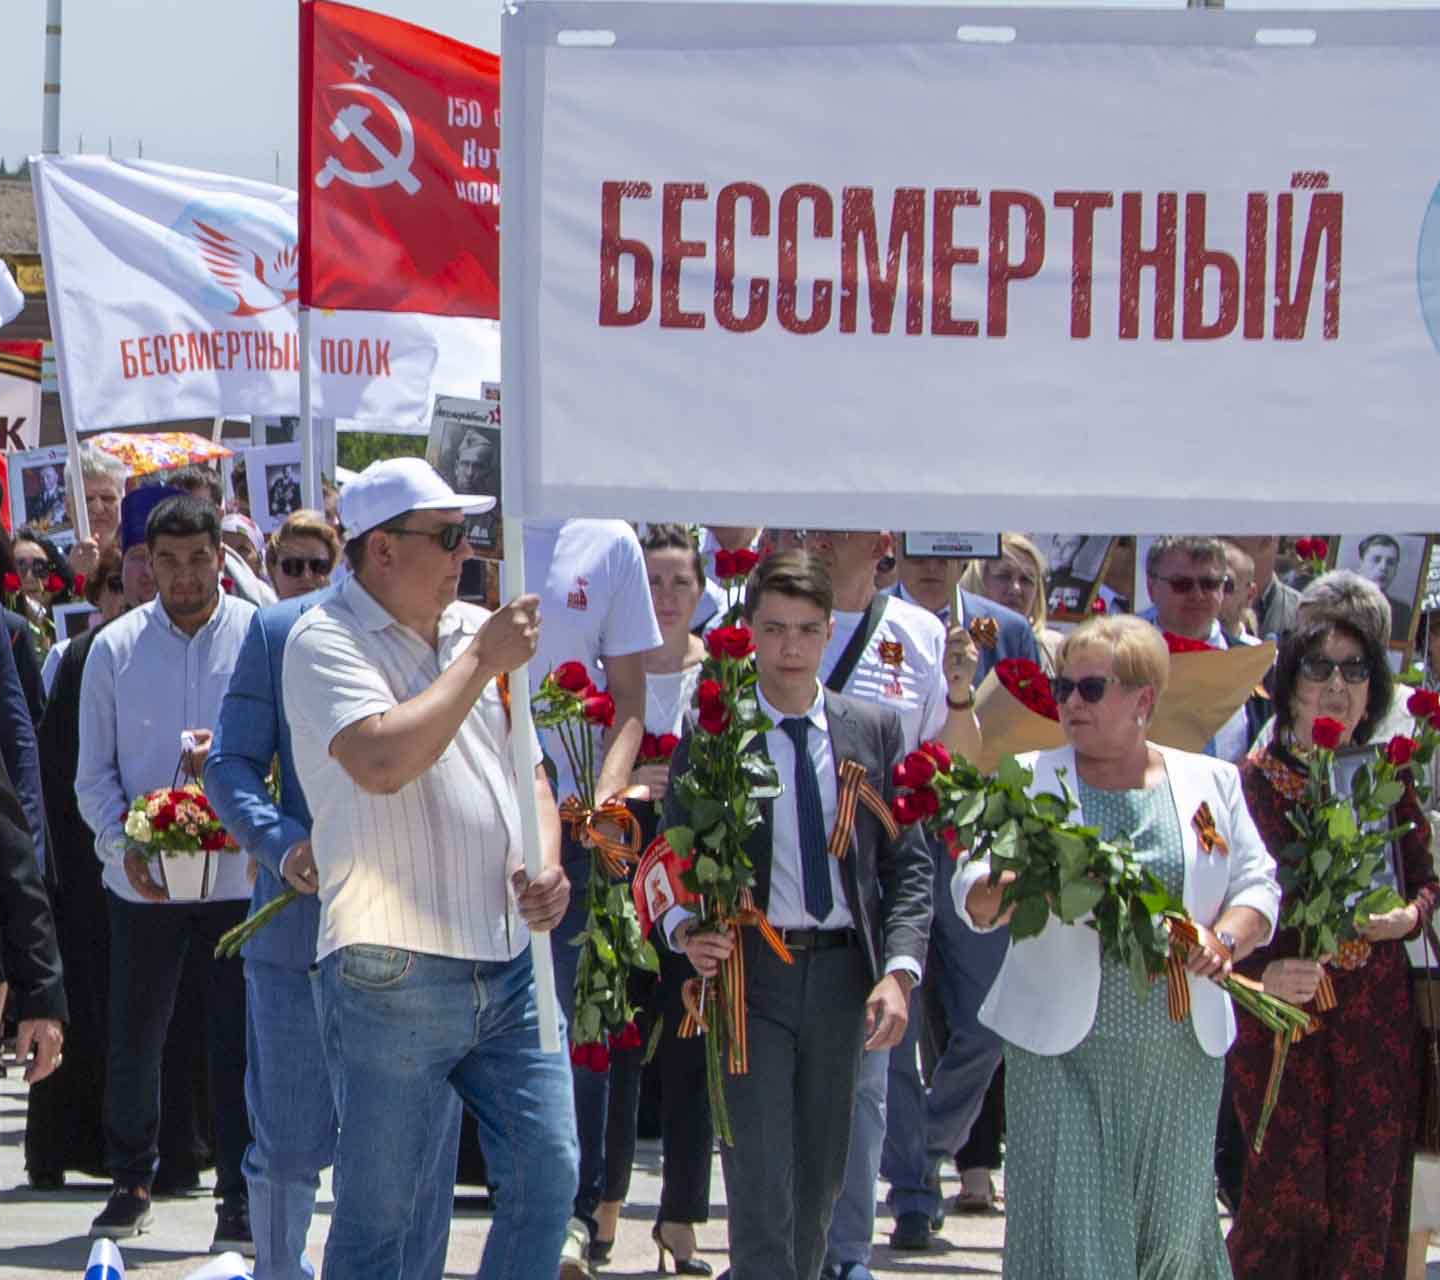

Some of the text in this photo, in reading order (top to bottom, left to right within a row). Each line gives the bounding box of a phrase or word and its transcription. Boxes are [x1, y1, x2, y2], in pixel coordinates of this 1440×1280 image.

[447, 96, 482, 128] 150
[599, 170, 1344, 340] БЕССМЕРТНЫЙ
[320, 338, 391, 377] ПОЛК
